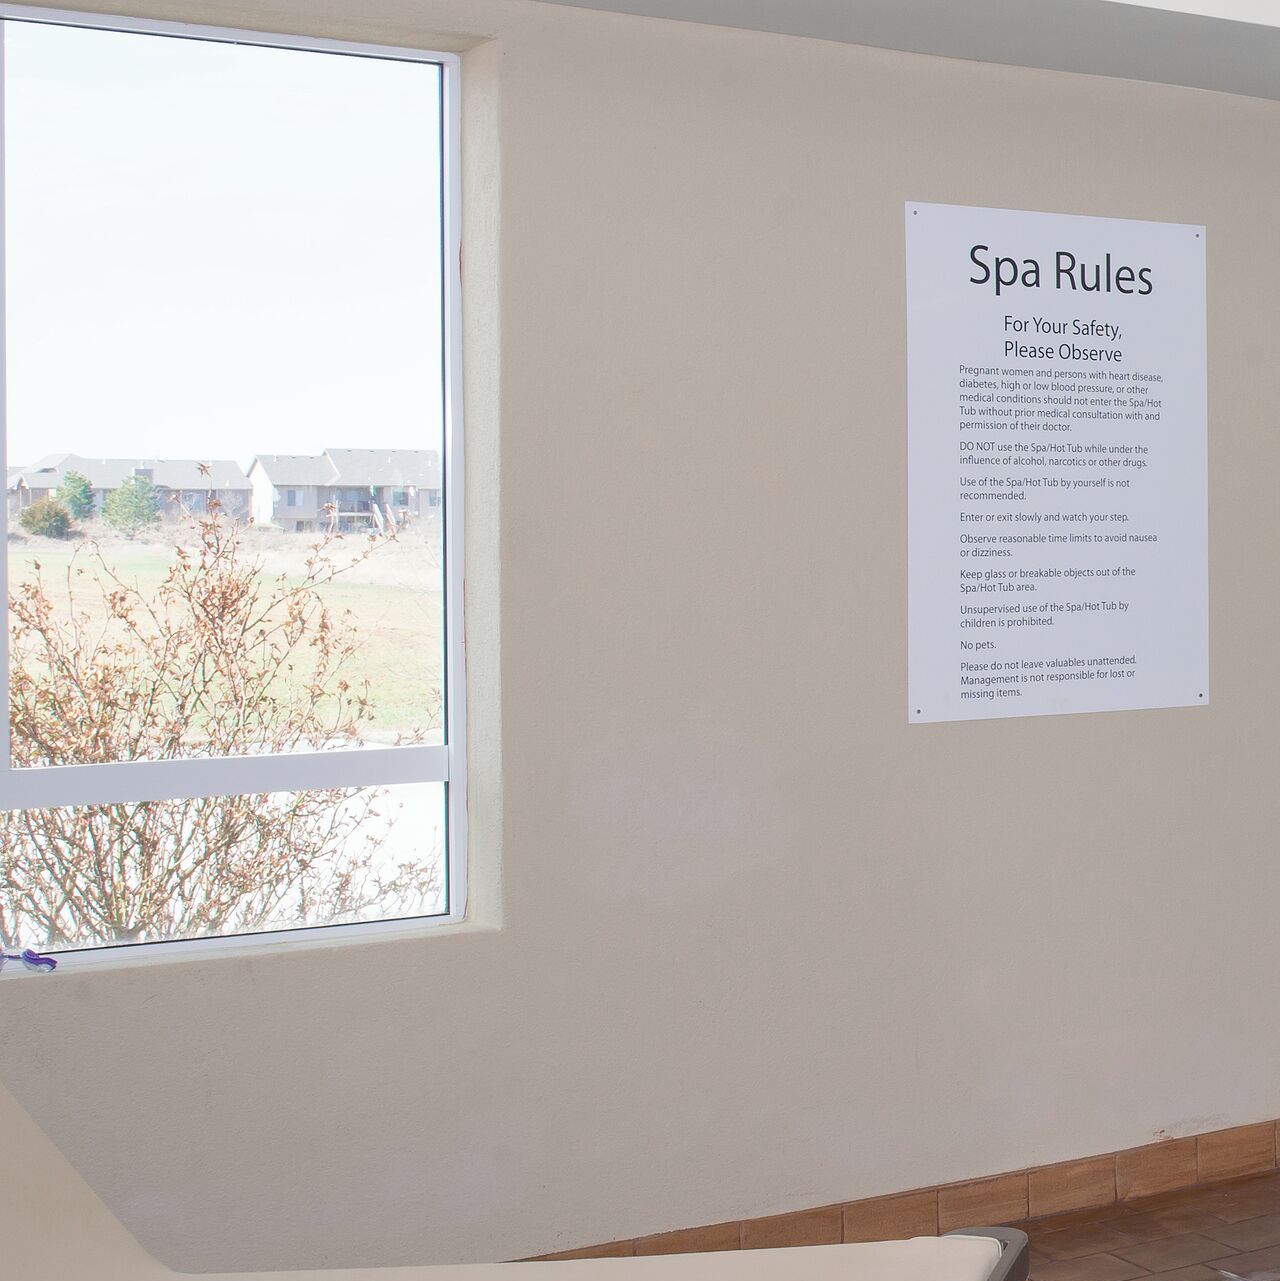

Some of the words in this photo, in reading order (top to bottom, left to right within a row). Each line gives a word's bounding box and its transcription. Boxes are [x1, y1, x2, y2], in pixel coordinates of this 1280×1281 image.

[969, 244, 1041, 296] Spa
[1055, 251, 1153, 296] Rules
[1004, 315, 1030, 333] For
[1032, 316, 1069, 335] Your
[1072, 319, 1122, 342] Safety,
[1004, 340, 1055, 359] Please
[1058, 343, 1122, 362] Observe
[959, 364, 1000, 378] Pregnant
[1001, 368, 1034, 377] women
[1035, 368, 1053, 378] and
[1054, 370, 1087, 380] persons
[1088, 370, 1107, 380] with
[1108, 370, 1130, 381] heart
[1131, 371, 1163, 383] disease,
[959, 378, 999, 390] diabetes,
[1000, 379, 1021, 392] high
[1022, 382, 1032, 391] or
[1033, 380, 1050, 391] low
[1051, 381, 1076, 392] blood
[1077, 384, 1115, 395] pressure,
[1115, 386, 1125, 394] or
[1126, 384, 1149, 395] other
[959, 392, 994, 403] medical
[995, 393, 1042, 405] conditions
[1043, 394, 1073, 405] should
[1073, 397, 1089, 406] not
[1089, 398, 1112, 407] enter
[1113, 397, 1128, 407] the
[1128, 397, 1162, 409] Spa/Hot
[959, 405, 977, 416] Tub
[978, 406, 1013, 417] without
[1014, 407, 1036, 419] prior
[1037, 408, 1071, 419] medical
[1071, 409, 1124, 420] consultation
[1124, 410, 1143, 421] with
[1144, 411, 1161, 421] and
[959, 419, 1008, 431] permission
[1009, 420, 1020, 431] of
[1020, 421, 1041, 431] their
[1042, 421, 1072, 432] doctor.
[959, 441, 975, 451] DO
[976, 441, 996, 452] NOT
[997, 444, 1013, 452] use
[1014, 442, 1029, 453] the
[1030, 442, 1066, 455] Spa/Hot
[1066, 443, 1083, 453] Tub
[1084, 443, 1107, 454] while
[1108, 444, 1133, 454] under
[1134, 444, 1149, 455] the
[959, 454, 1001, 466] influence
[1002, 455, 1012, 465] of
[1013, 455, 1047, 467] alcohol,
[1048, 456, 1087, 467] narcotics
[1087, 459, 1098, 467] or
[1098, 456, 1122, 467] other
[1122, 457, 1148, 470] drugs.
[959, 477, 977, 487] Use
[978, 476, 988, 487] of
[989, 477, 1005, 487] the
[1006, 477, 1041, 489] Spa/Hot
[1042, 477, 1059, 487] Tub
[1060, 477, 1072, 489] by
[1072, 477, 1106, 489] yourself
[1107, 478, 1115, 488] is
[1115, 479, 1130, 488] not
[960, 490, 1027, 501] recommended.
[960, 512, 984, 522] Enter
[985, 514, 995, 522] or
[996, 512, 1013, 522] exit
[1014, 512, 1043, 524] slowly
[1043, 512, 1060, 522] and
[1061, 512, 1088, 522] watch
[1089, 514, 1109, 524] your
[1109, 513, 1129, 523] step.
[959, 533, 997, 544] Observe
[998, 533, 1047, 544] reasonable
[1048, 533, 1068, 543] time
[1069, 533, 1093, 543] limits
[1093, 534, 1103, 543] to
[1104, 532, 1128, 543] avoid
[1128, 534, 1158, 543] nausea
[959, 549, 970, 558] or
[971, 547, 1013, 558] dizziness.
[960, 569, 983, 581] Keep
[984, 569, 1007, 582] glass
[1008, 570, 1018, 579] or
[1019, 568, 1062, 578] breakable
[1063, 567, 1095, 580] objects
[1095, 568, 1110, 577] out
[1111, 566, 1121, 577] of
[1121, 566, 1136, 576] the
[960, 582, 996, 595] Spa/Hot
[997, 582, 1015, 592] Tub
[1016, 583, 1038, 592] area.
[960, 603, 1021, 616] Unsupervised
[1022, 605, 1038, 613] use
[1038, 602, 1049, 613] of
[1049, 602, 1065, 612] the
[1065, 601, 1100, 614] Spa/Hot
[1100, 601, 1118, 611] Tub
[1118, 600, 1129, 612] by
[960, 617, 997, 629] children
[998, 617, 1006, 627] is
[1007, 615, 1054, 629] prohibited.
[960, 640, 974, 650] No
[975, 641, 997, 652] pets.
